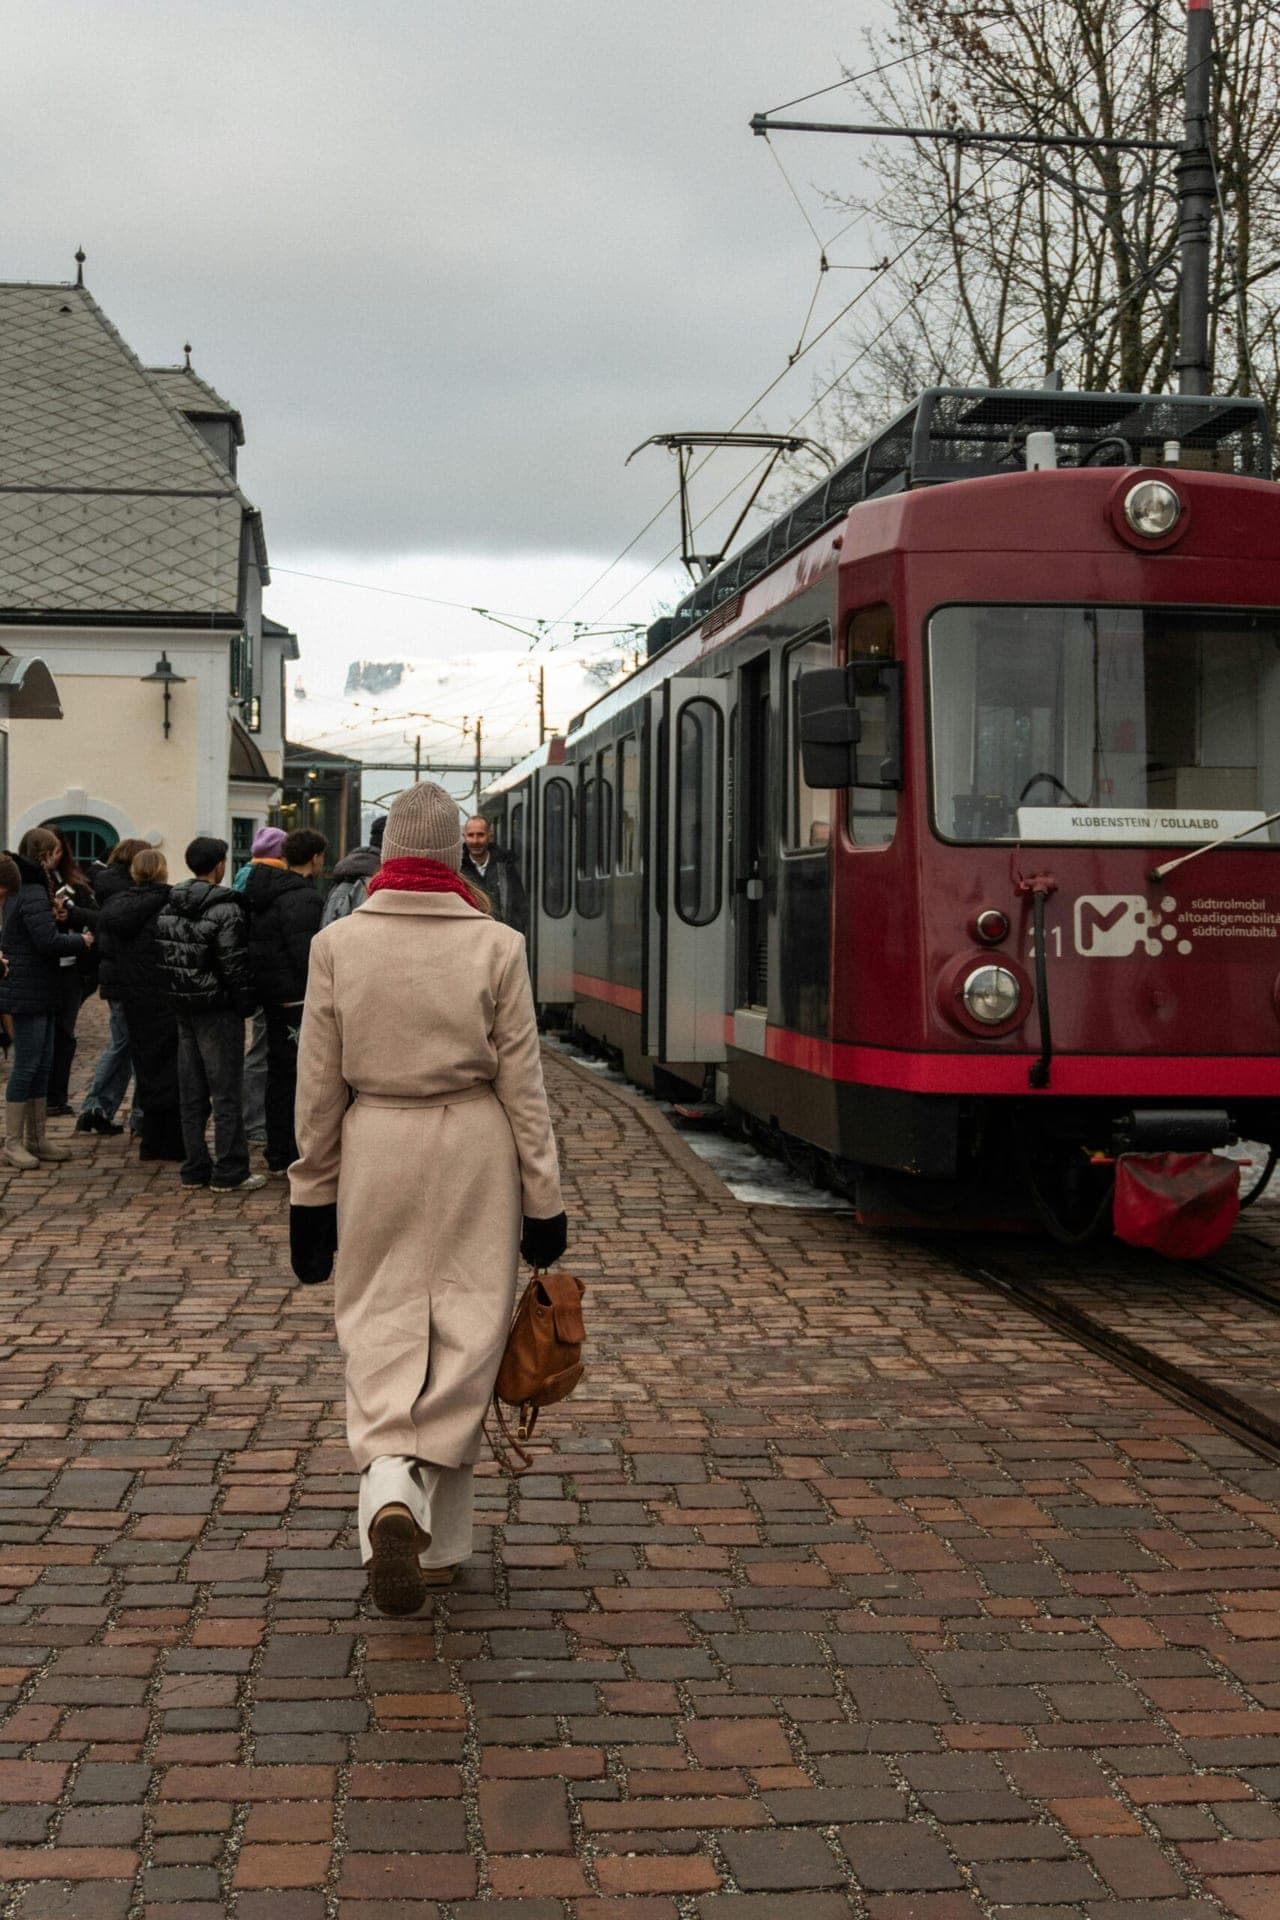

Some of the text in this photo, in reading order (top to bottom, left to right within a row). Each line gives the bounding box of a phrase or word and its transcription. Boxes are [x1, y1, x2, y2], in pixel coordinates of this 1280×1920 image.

[1071, 816, 1150, 828] KLOBENSTEIN
[1160, 818, 1219, 829] COLLALBO
[1191, 898, 1266, 910] südtirolmobil
